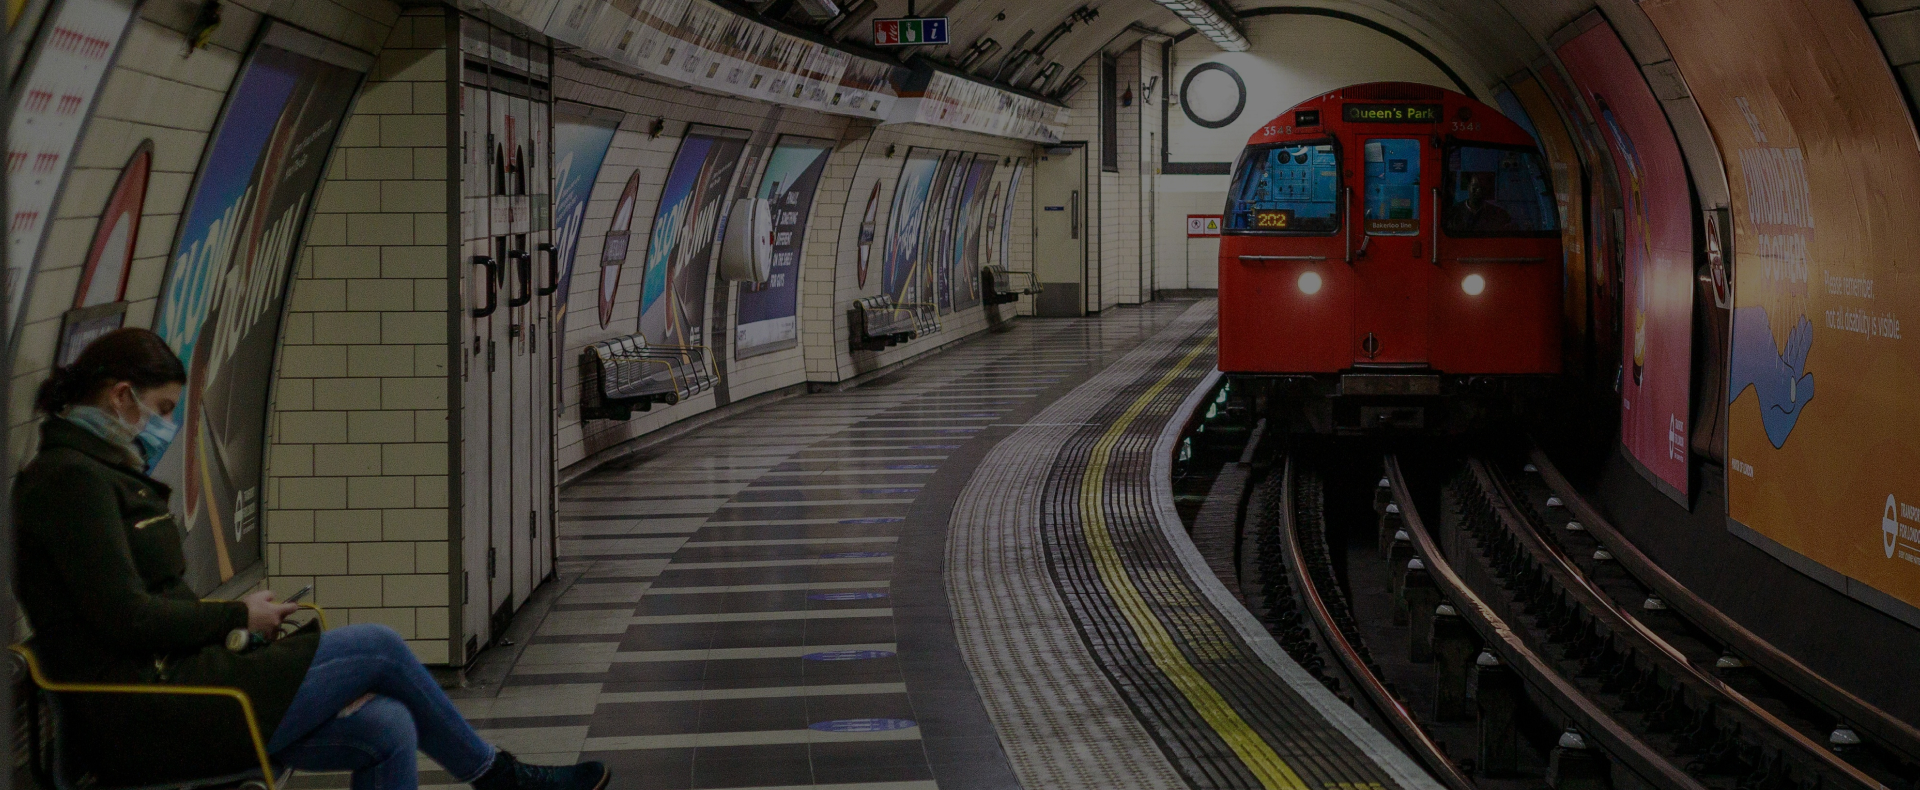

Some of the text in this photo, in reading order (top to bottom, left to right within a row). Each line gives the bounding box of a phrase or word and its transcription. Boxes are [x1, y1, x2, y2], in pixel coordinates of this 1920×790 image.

[1350, 107, 1435, 120] Queen's Park
[1452, 122, 1481, 132] 3548
[1263, 126, 1292, 136] 3548
[1738, 147, 1814, 228] CONSIDERATE
[649, 190, 694, 272] SLOW
[672, 193, 721, 280] DOWN
[1258, 214, 1286, 227] 202
[1759, 233, 1808, 283] TO OTHERS
[1824, 269, 1875, 302] Please remember,
[1825, 305, 1902, 341] not all disability is visible.
